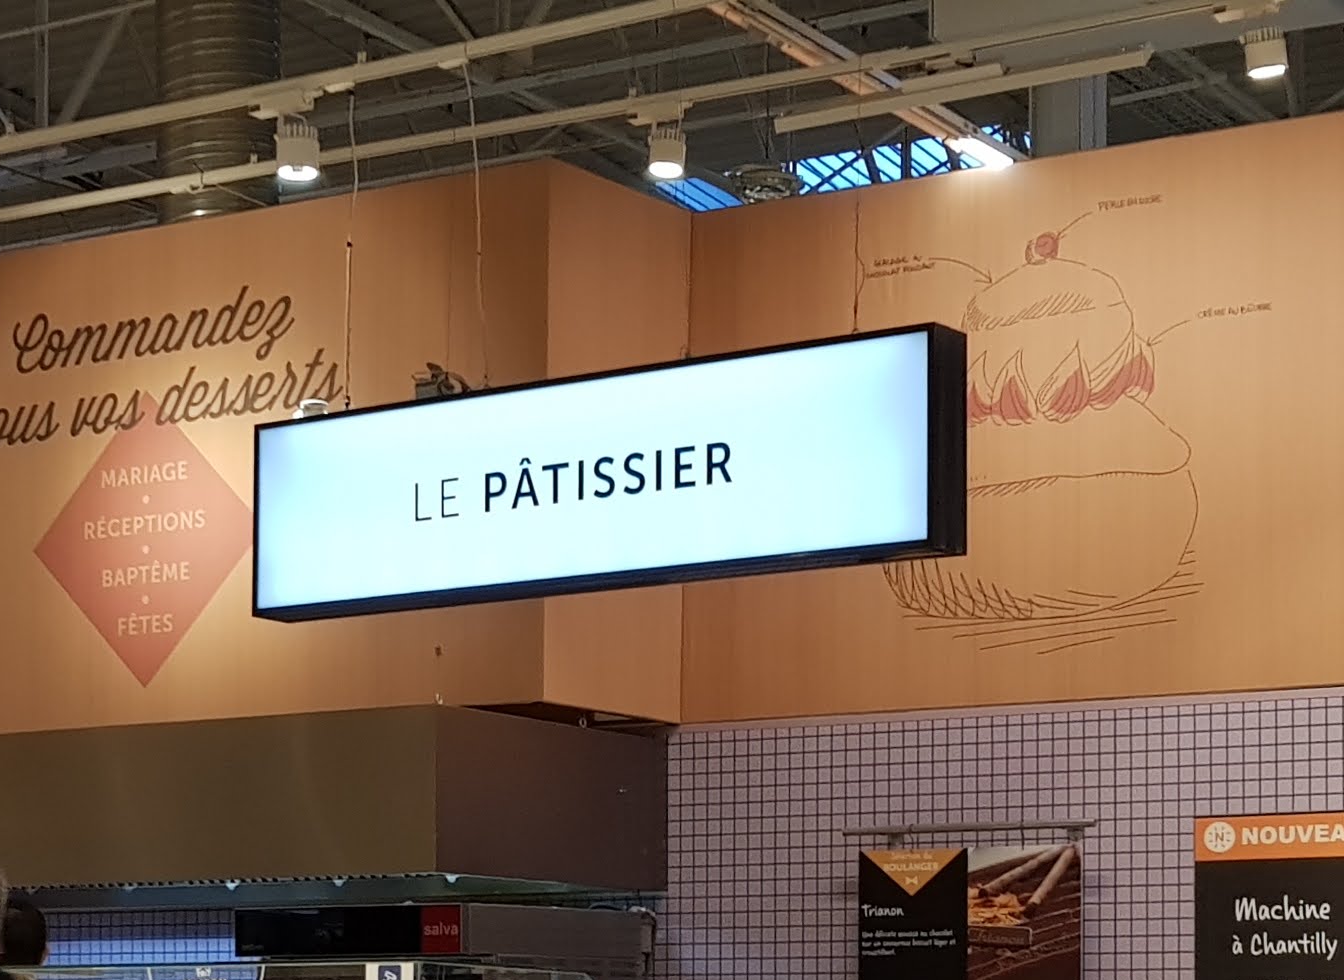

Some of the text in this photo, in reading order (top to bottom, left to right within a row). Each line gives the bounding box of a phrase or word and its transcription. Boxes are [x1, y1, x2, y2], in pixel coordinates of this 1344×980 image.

[12, 285, 295, 375] Commandez
[69, 388, 146, 438] vos
[156, 348, 344, 427] desserts
[100, 461, 189, 489] MARIAGE
[414, 440, 734, 522] LE PÂTISSIER
[83, 509, 207, 541] RÉCEPTIONS
[101, 561, 191, 589] BAPTÊME
[116, 613, 174, 638] FÊTES
[861, 904, 904, 917] Trianon
[1235, 895, 1331, 921] Machine
[423, 921, 460, 936] salva
[1232, 931, 1337, 960] à Chantilly
